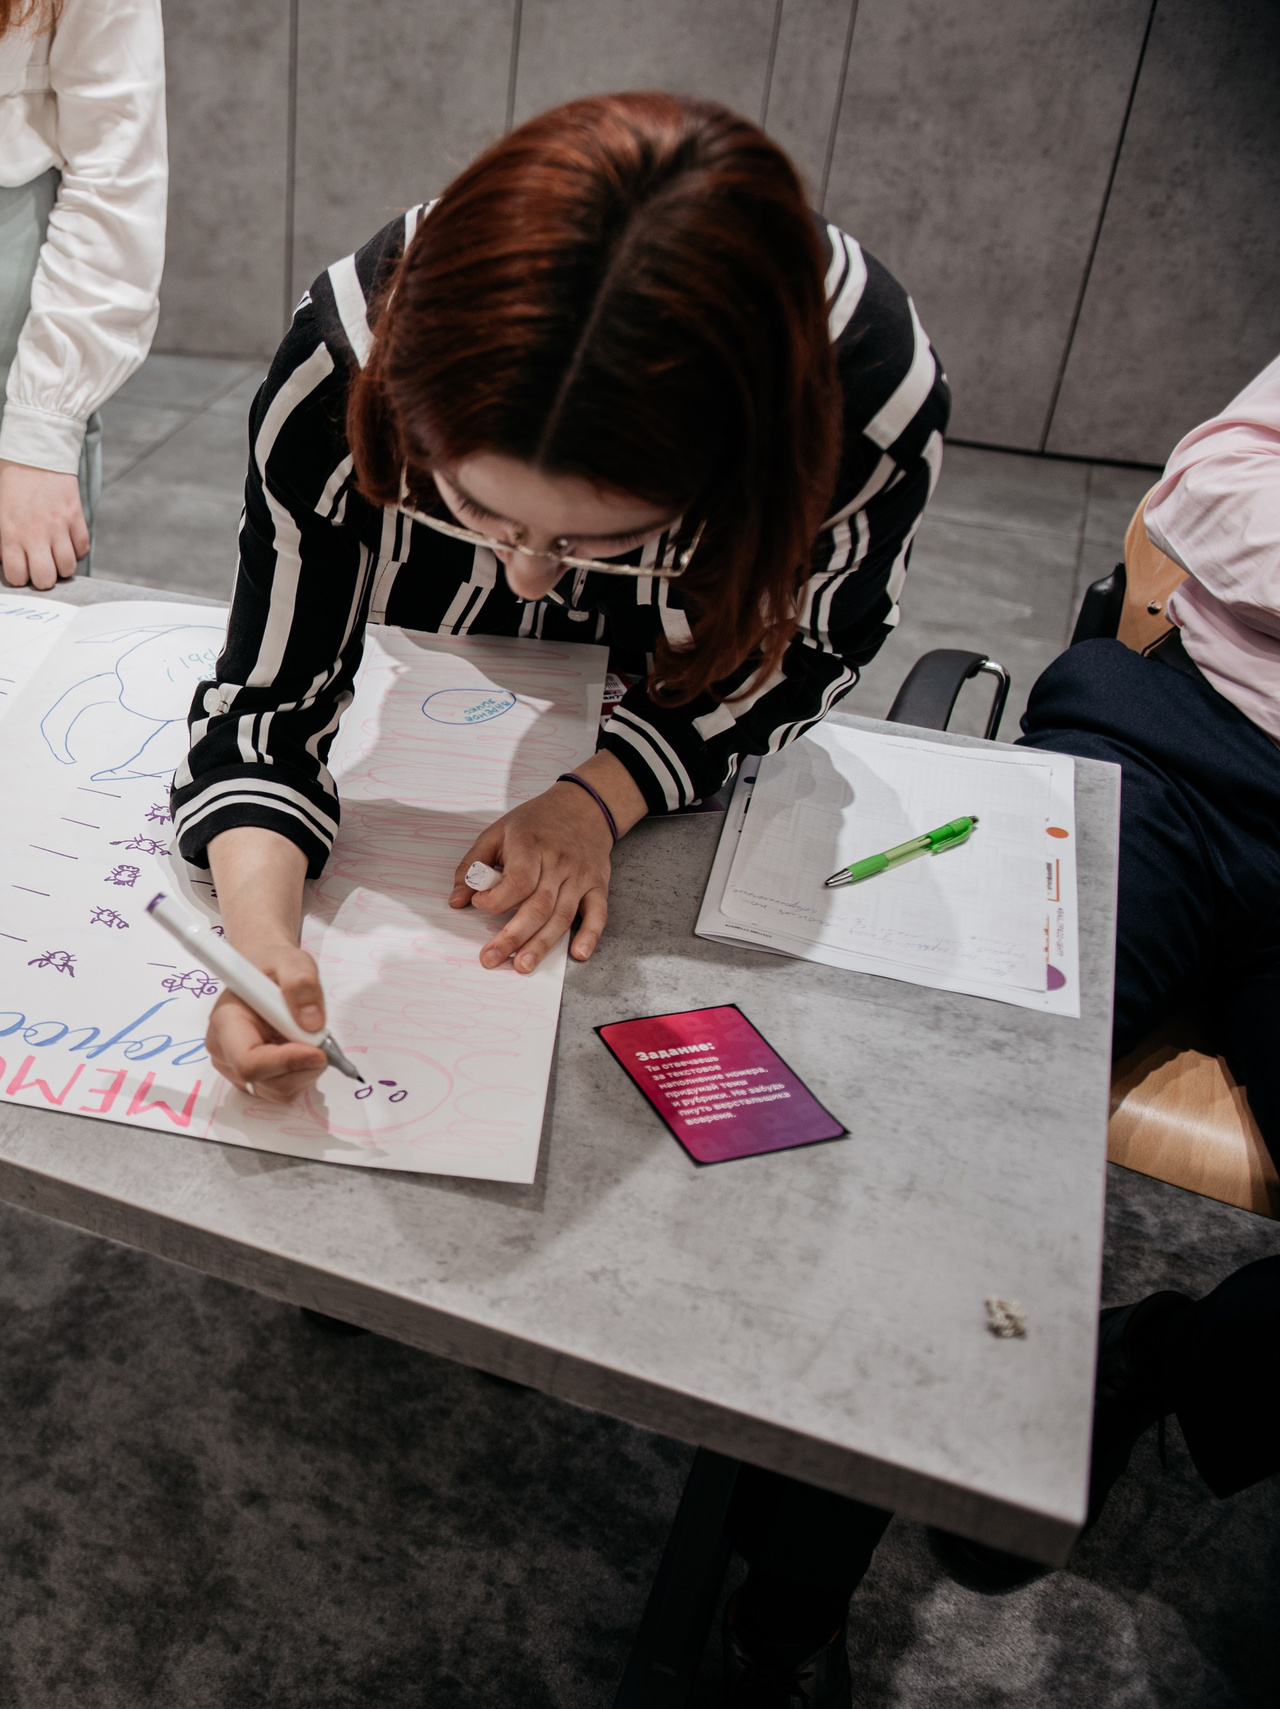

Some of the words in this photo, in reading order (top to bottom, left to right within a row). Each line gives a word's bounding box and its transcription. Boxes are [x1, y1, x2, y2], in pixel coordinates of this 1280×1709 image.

[635, 1042, 716, 1061] Задание:
[645, 1065, 661, 1073] Ты
[662, 1055, 719, 1071] отвечаешь
[668, 1064, 722, 1079] текстовое
[658, 1073, 725, 1090] наполнение
[664, 1083, 719, 1099] придумай
[719, 1079, 749, 1090] темы
[671, 1100, 681, 1108] и
[682, 1091, 731, 1108] рубрики.
[729, 1088, 748, 1098] Не
[748, 1082, 785, 1095] забудь
[677, 1105, 713, 1117] пнуть
[713, 1091, 792, 1111] верстальщика
